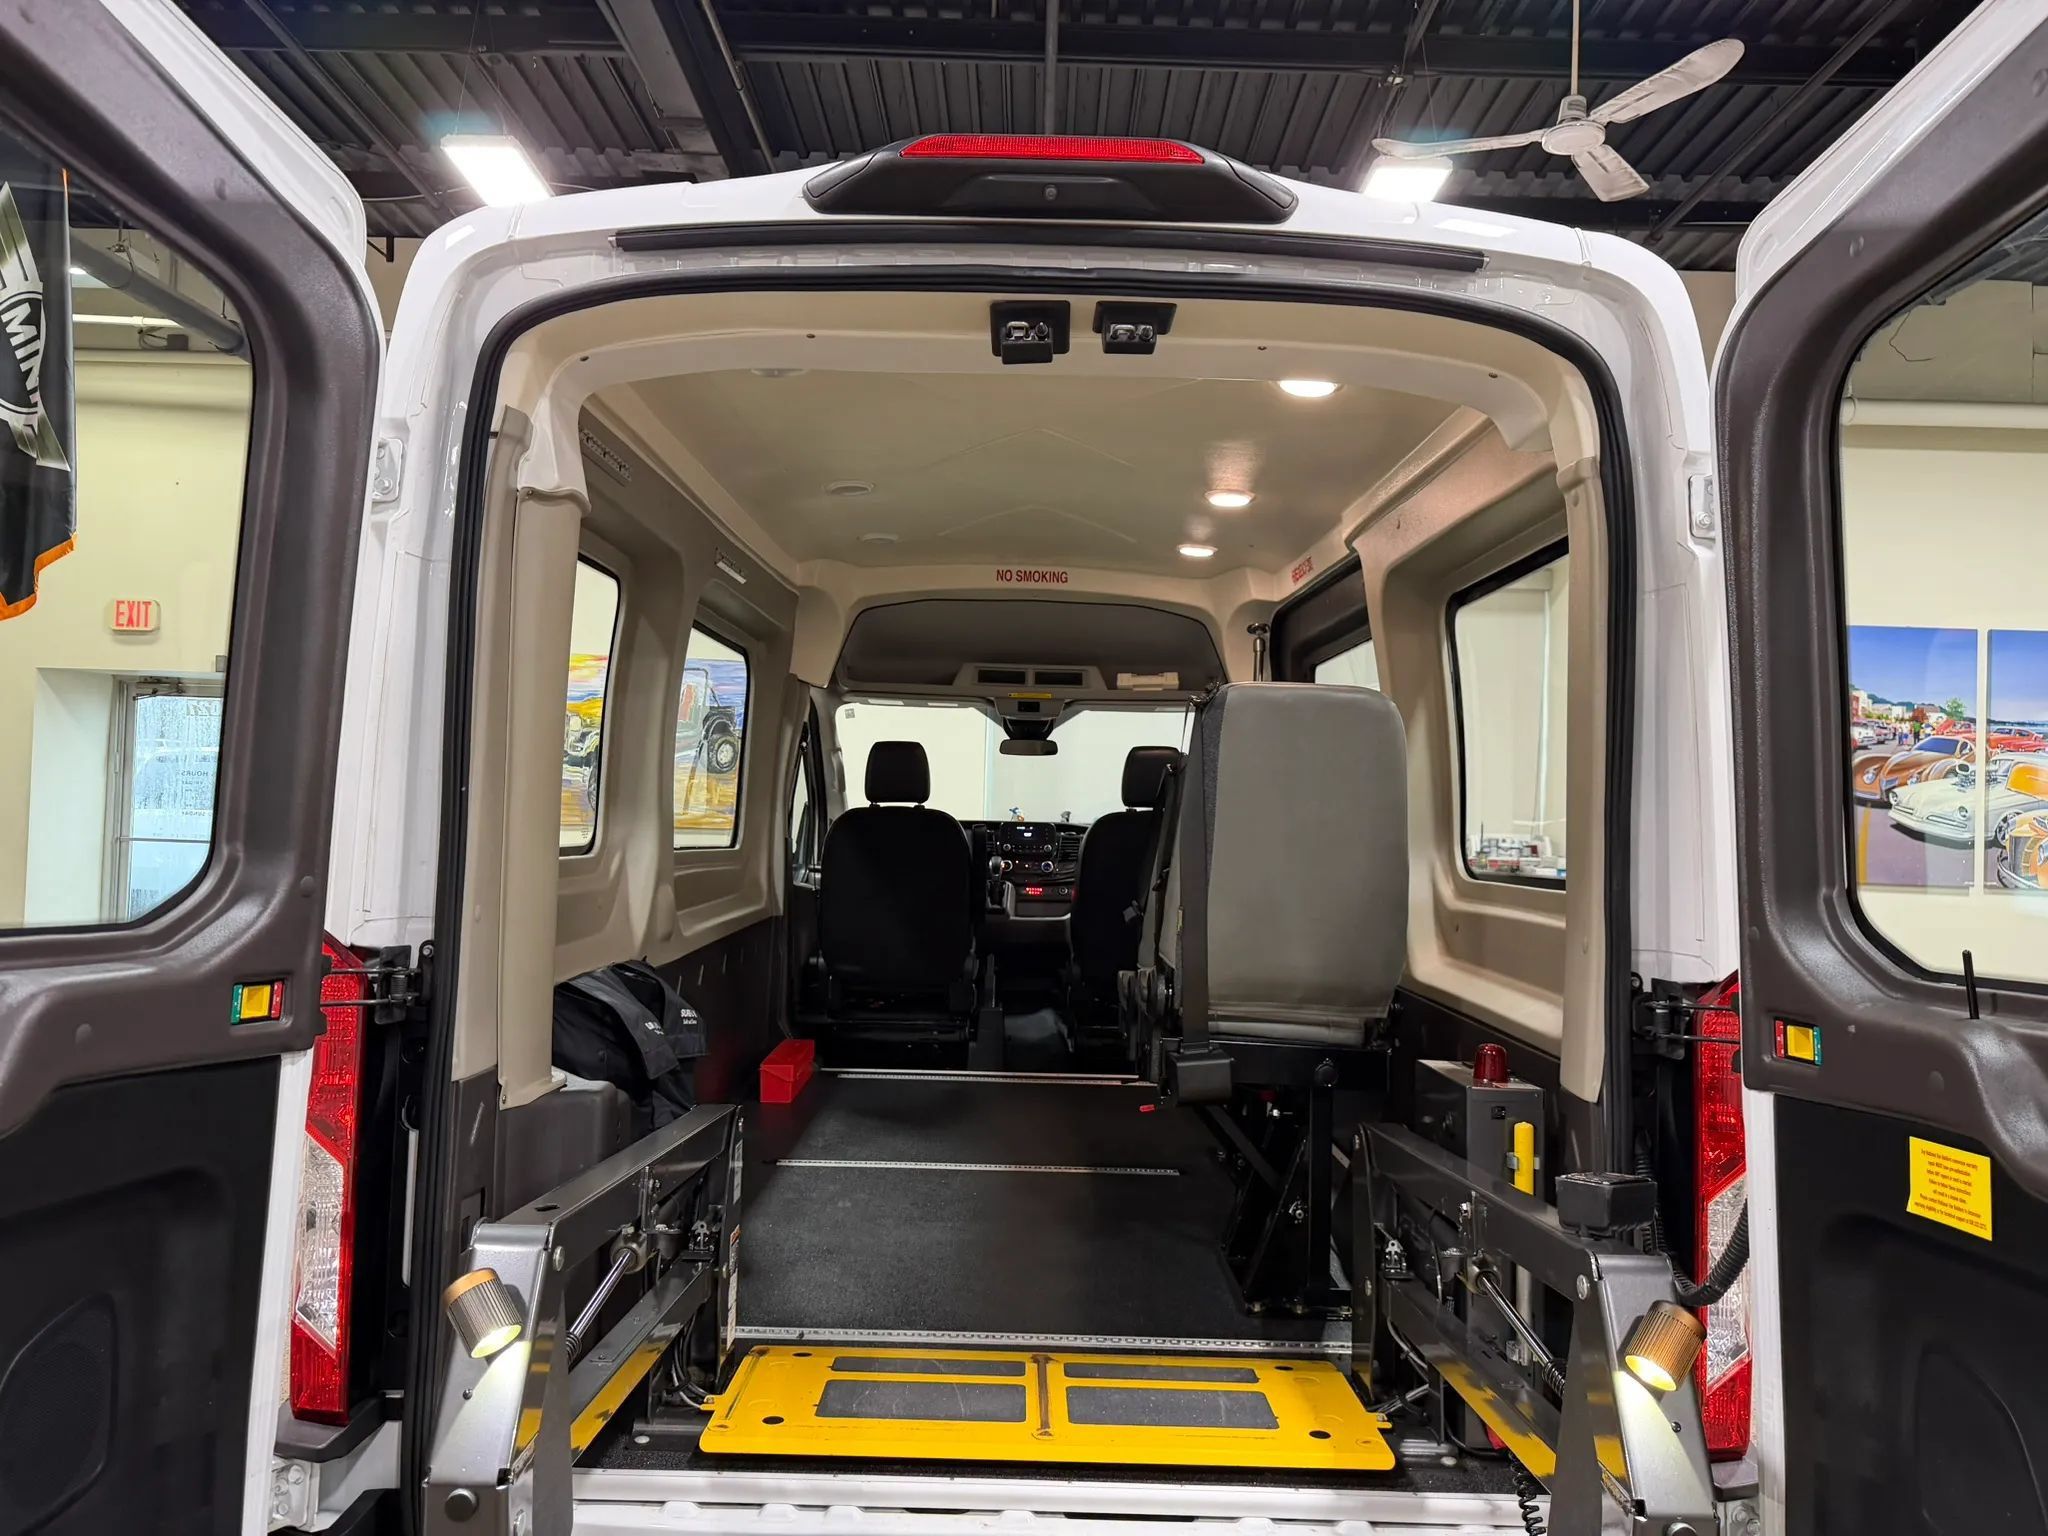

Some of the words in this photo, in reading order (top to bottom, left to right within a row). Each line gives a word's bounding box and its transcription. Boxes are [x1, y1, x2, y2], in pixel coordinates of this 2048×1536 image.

[996, 569, 1013, 582] NO
[1015, 569, 1069, 584] SMOKING
[115, 600, 153, 628] EXIT
